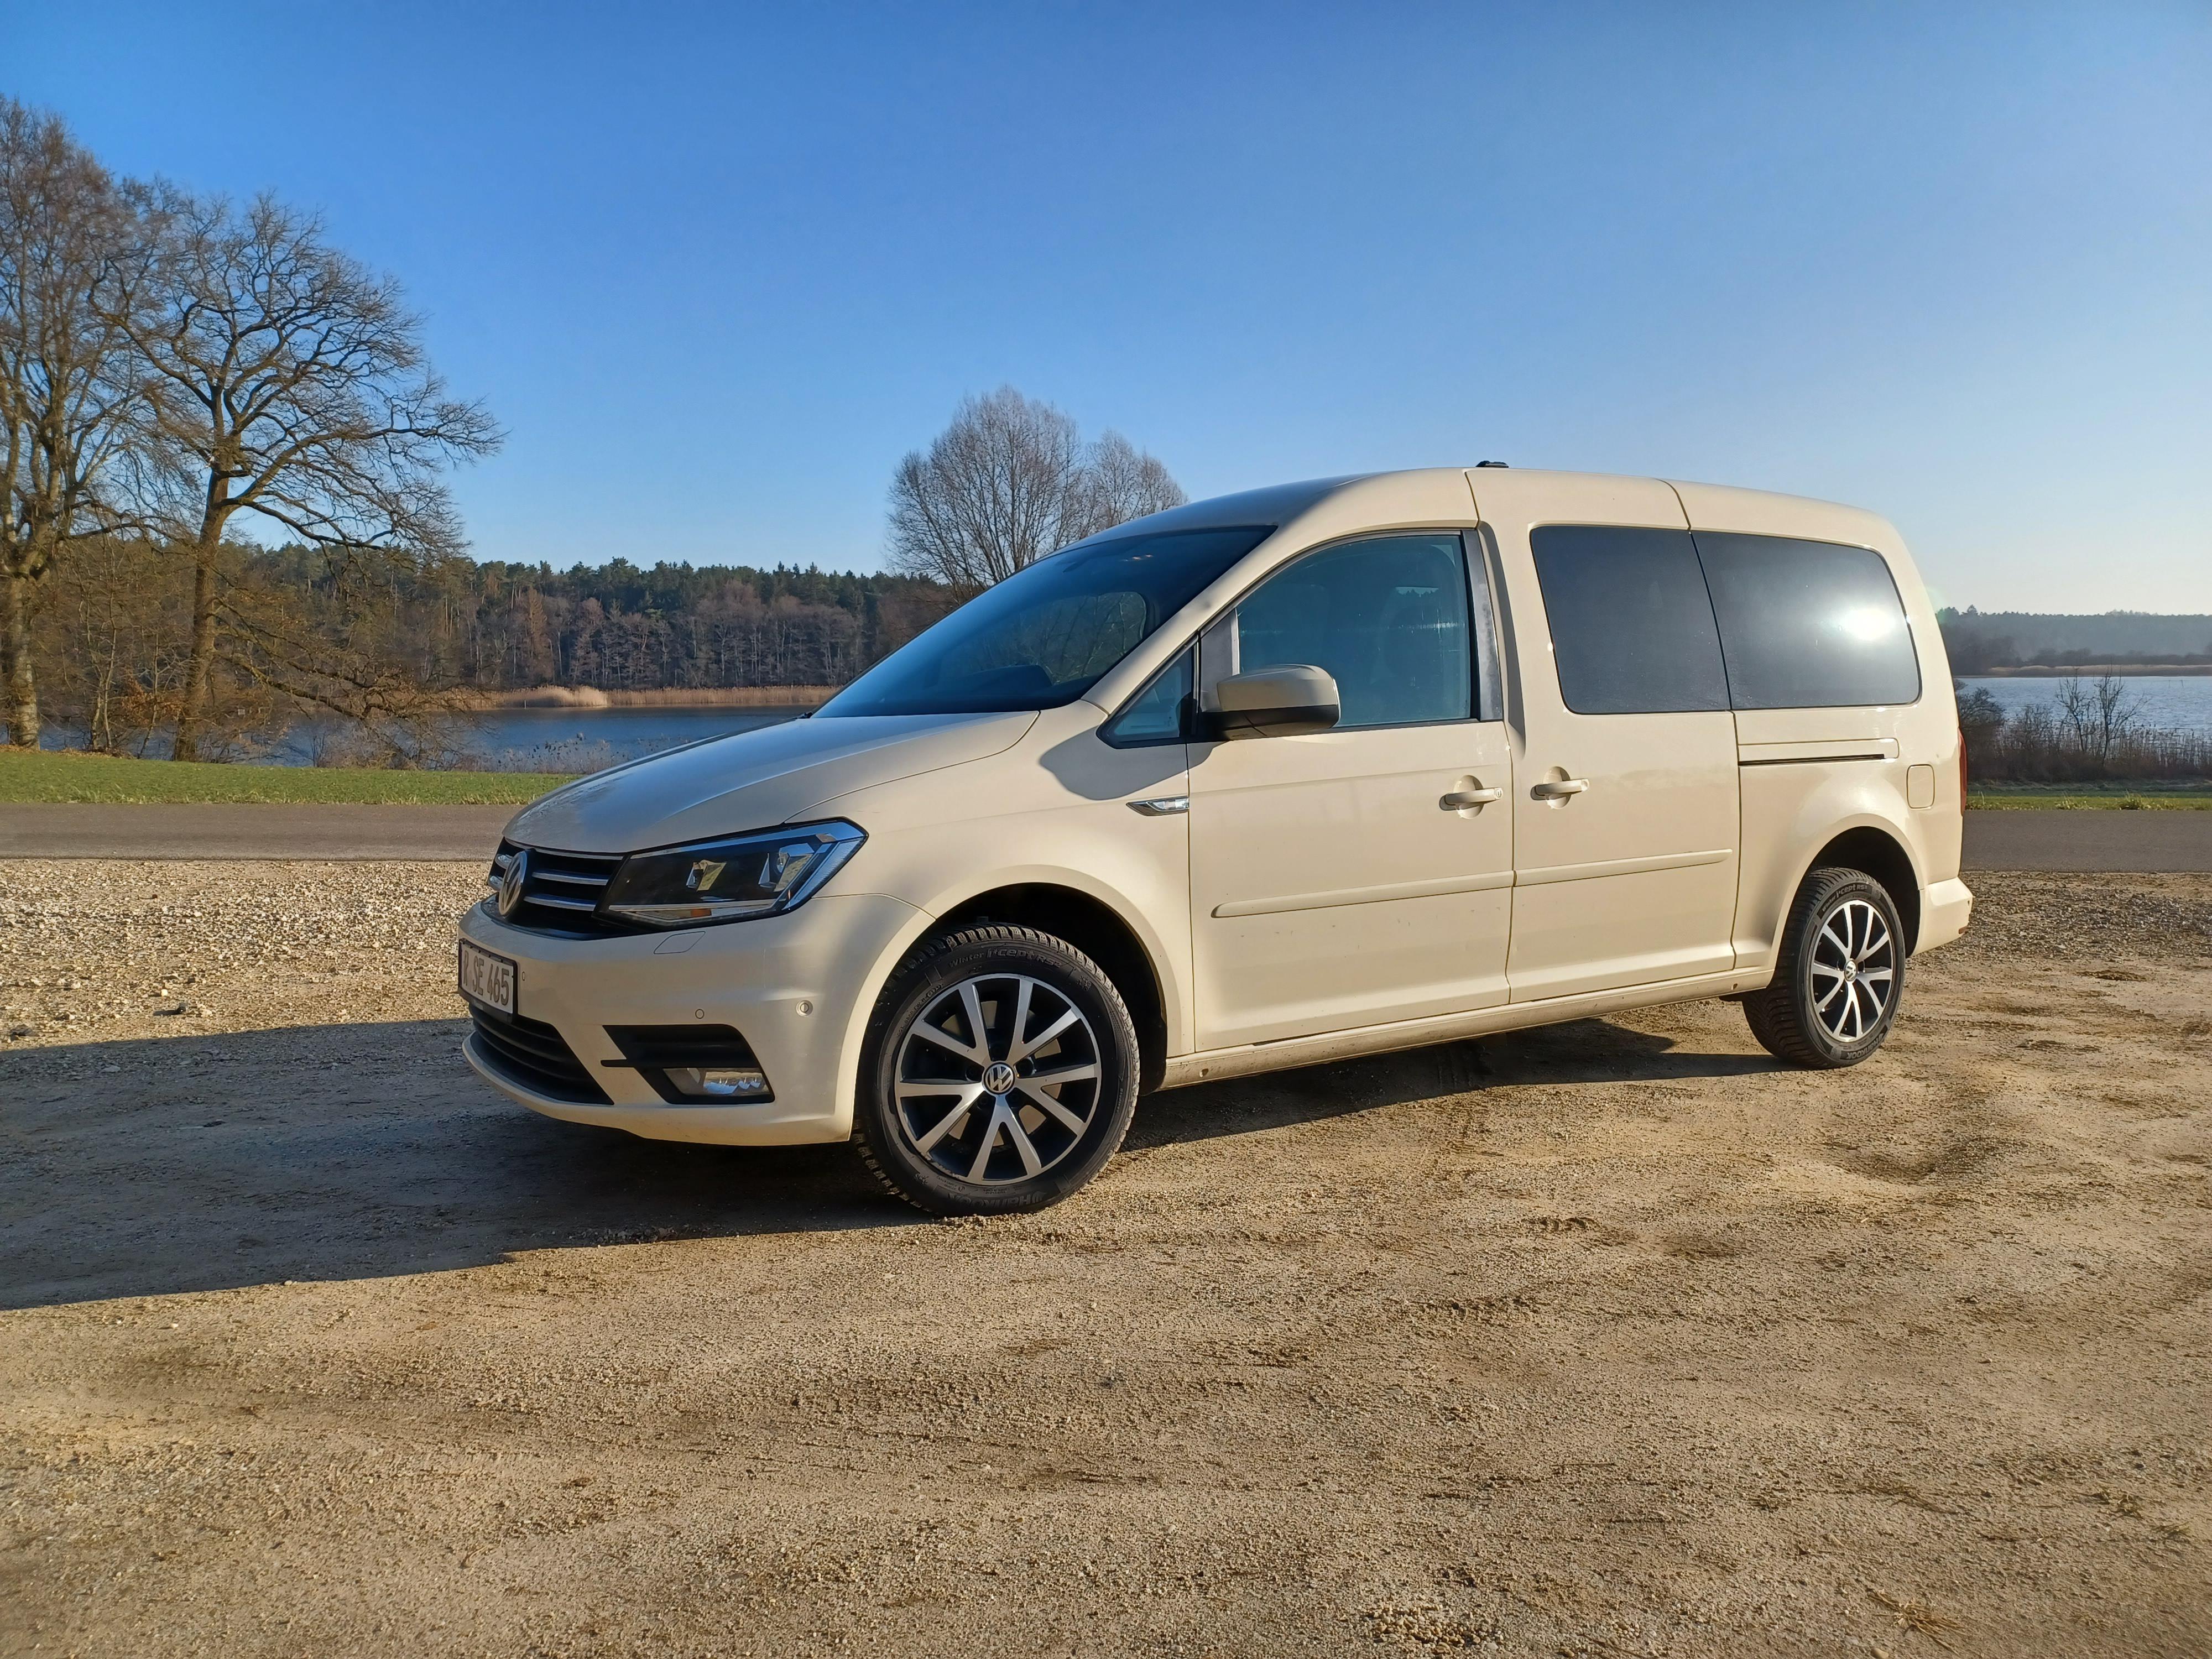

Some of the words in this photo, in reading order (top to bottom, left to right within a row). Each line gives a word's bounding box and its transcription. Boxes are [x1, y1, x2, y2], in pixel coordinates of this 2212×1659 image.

[947, 952, 984, 969] Winter
[1036, 954, 1063, 968] RS2
[463, 950, 469, 987] R
[472, 955, 484, 996] SE
[487, 963, 510, 1006] 465
[985, 1064, 1014, 1093] VW
